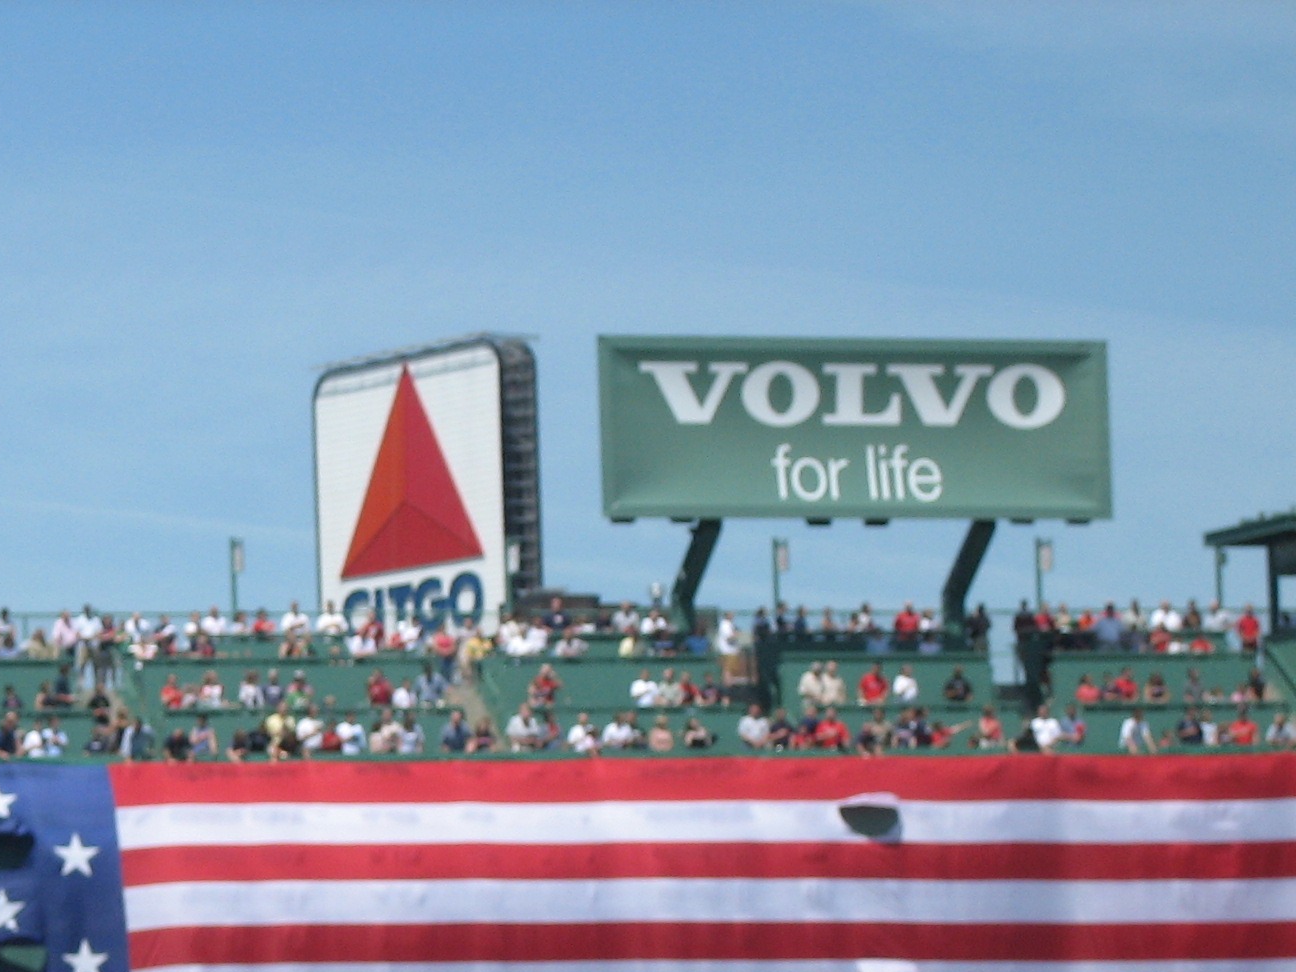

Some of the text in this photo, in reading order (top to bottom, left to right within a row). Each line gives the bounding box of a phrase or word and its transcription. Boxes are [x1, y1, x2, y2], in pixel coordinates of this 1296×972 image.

[638, 360, 1066, 430] VOLVO
[770, 443, 943, 501] for life
[343, 571, 484, 636] CITGO
